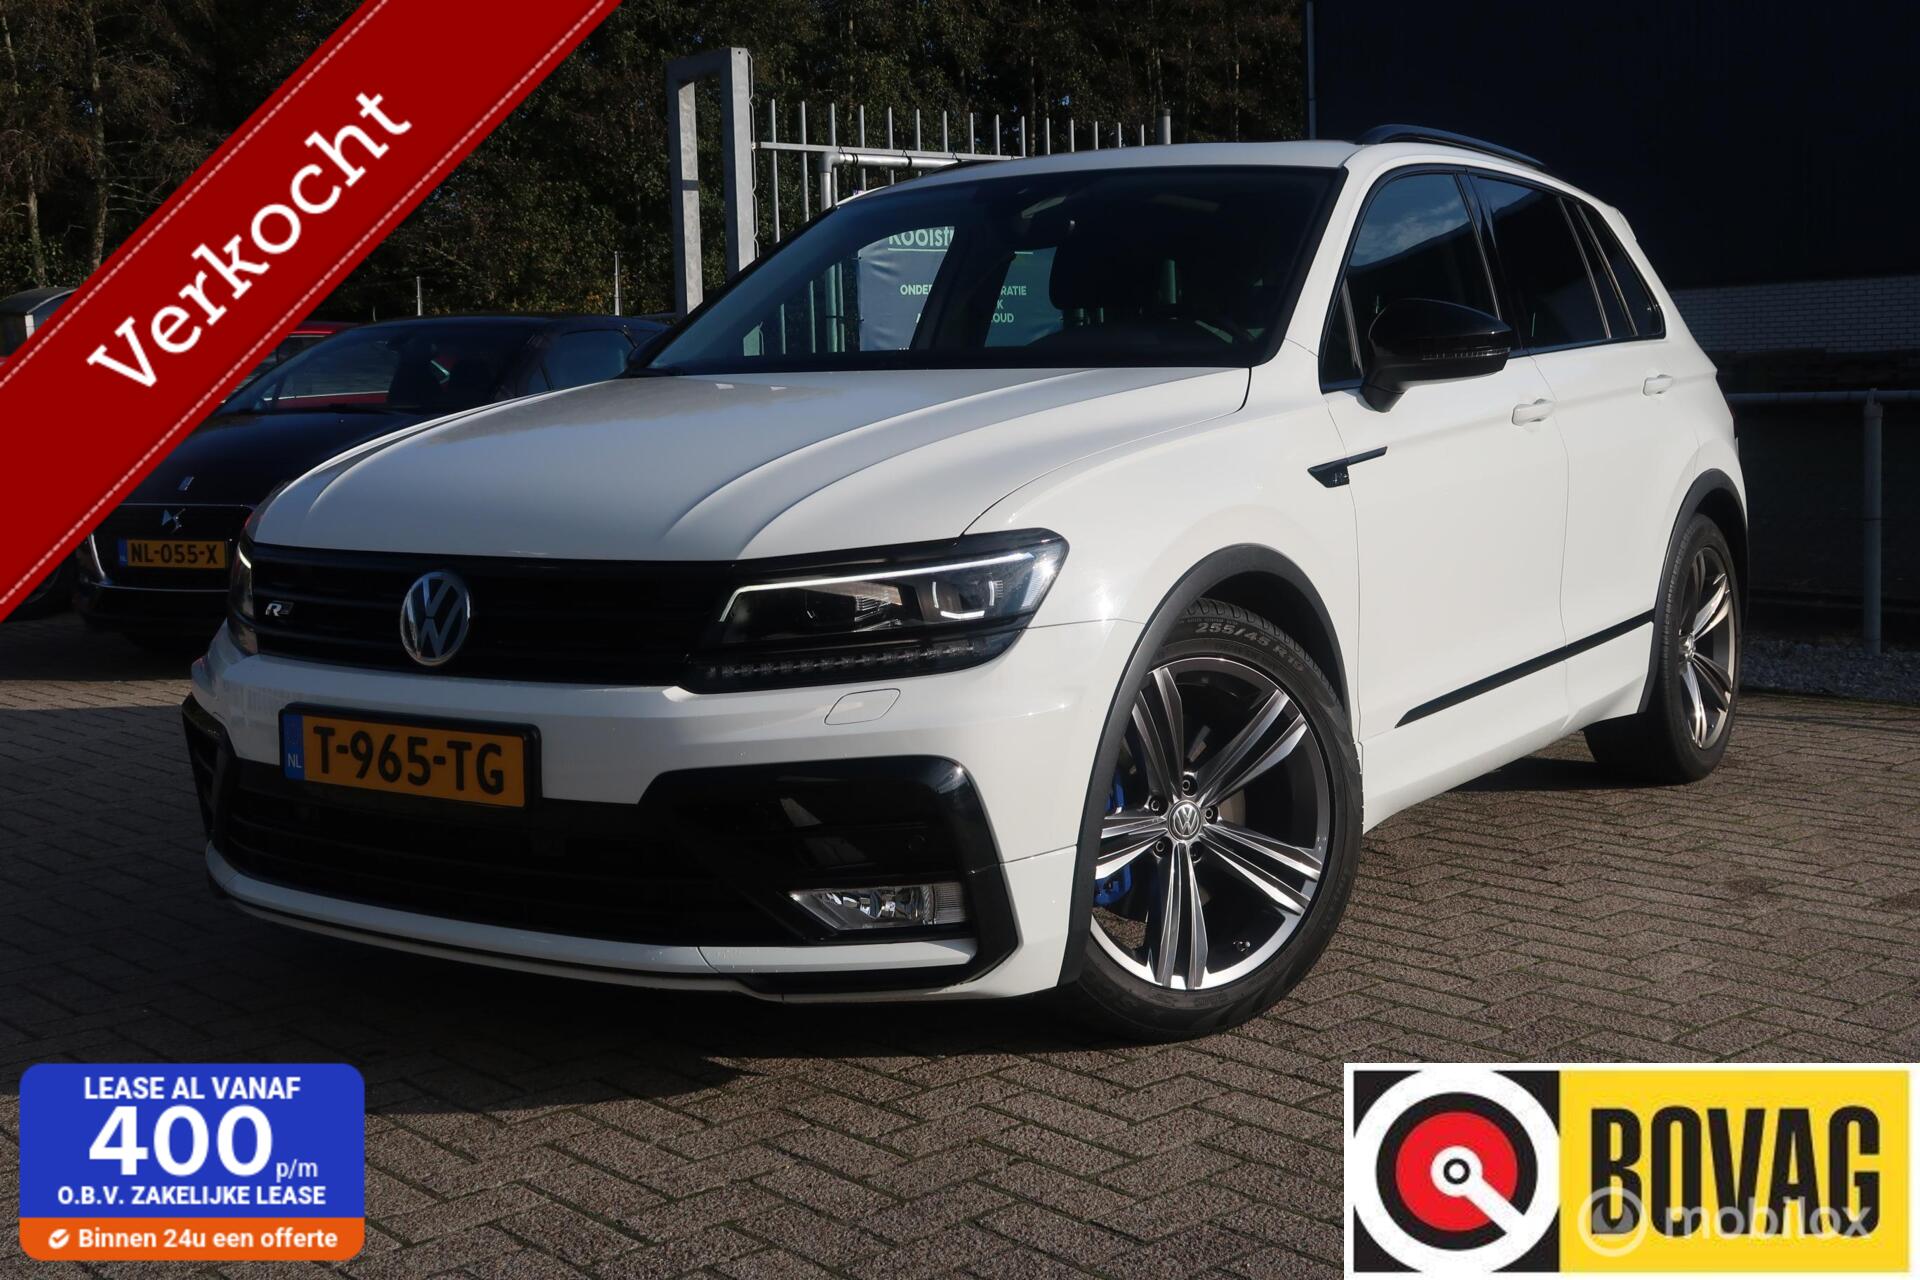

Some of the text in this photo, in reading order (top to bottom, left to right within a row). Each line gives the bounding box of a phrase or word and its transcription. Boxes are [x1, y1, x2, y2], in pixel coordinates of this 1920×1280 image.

[889, 226, 954, 247] ooist
[991, 312, 1015, 323] OUD
[130, 542, 219, 566] NL-055-X
[287, 725, 505, 796] NL T-965-TG
